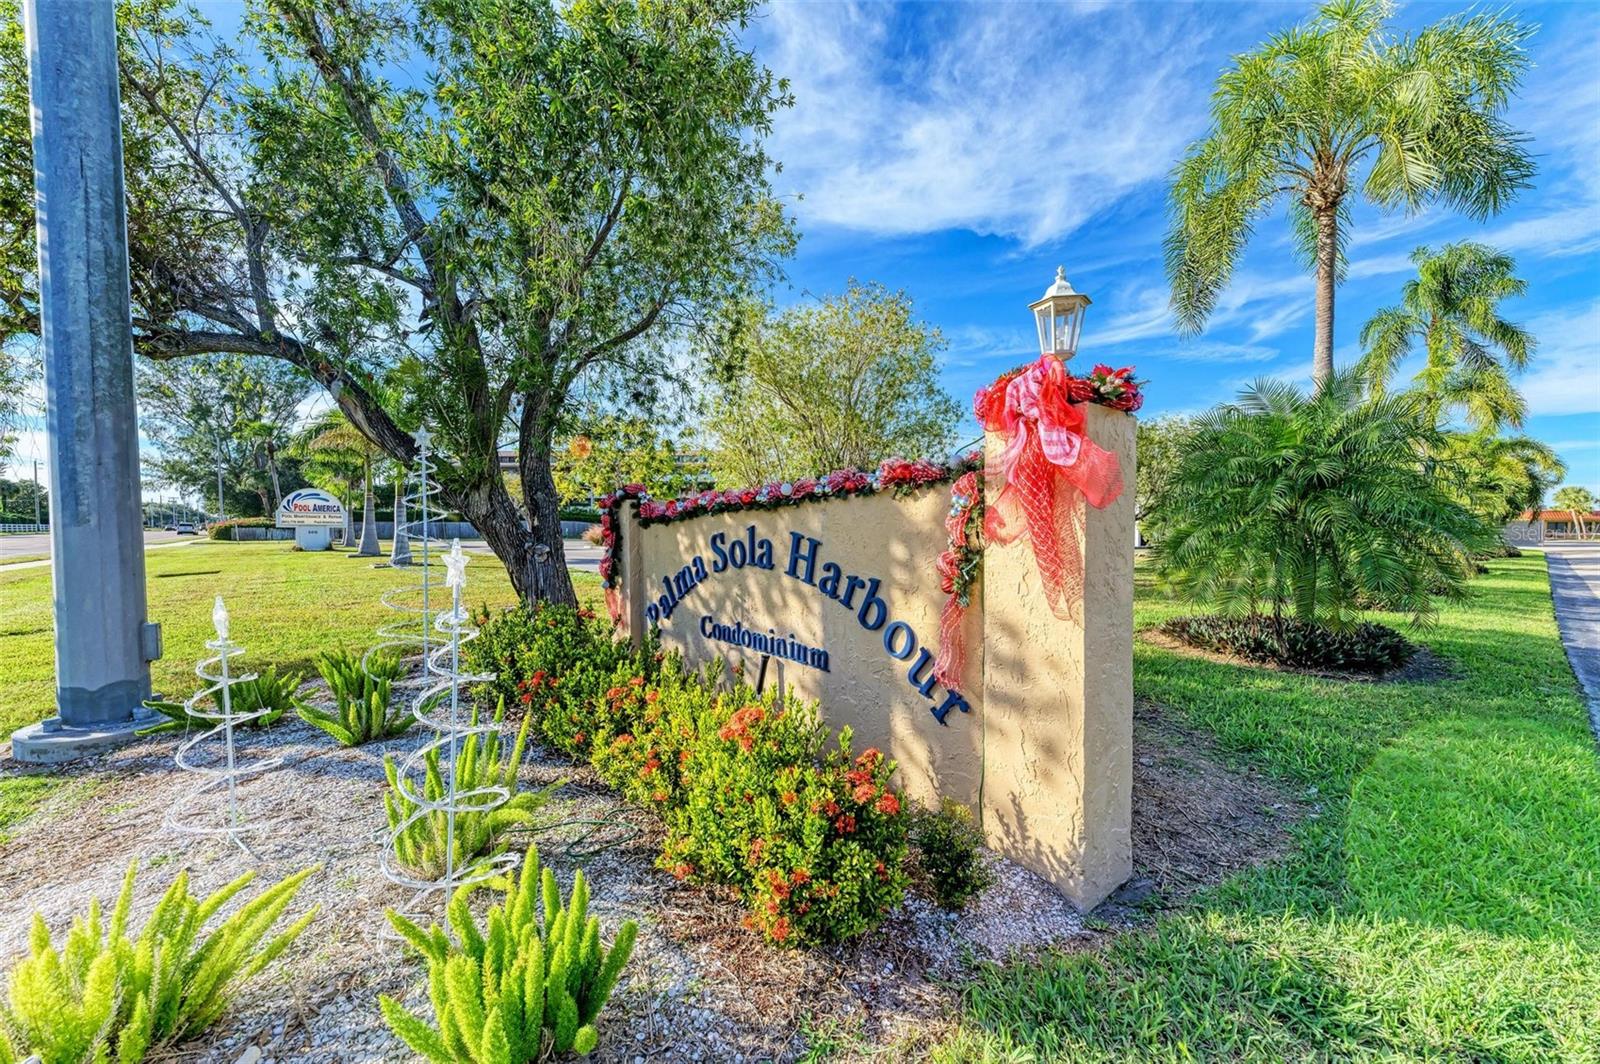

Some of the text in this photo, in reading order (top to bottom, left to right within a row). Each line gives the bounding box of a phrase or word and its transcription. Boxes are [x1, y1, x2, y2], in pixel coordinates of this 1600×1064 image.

[293, 503, 341, 512] POOL AMERICA
[700, 615, 831, 673] Condominium
[710, 525, 775, 573] Sola
[784, 531, 970, 727] Harbour
